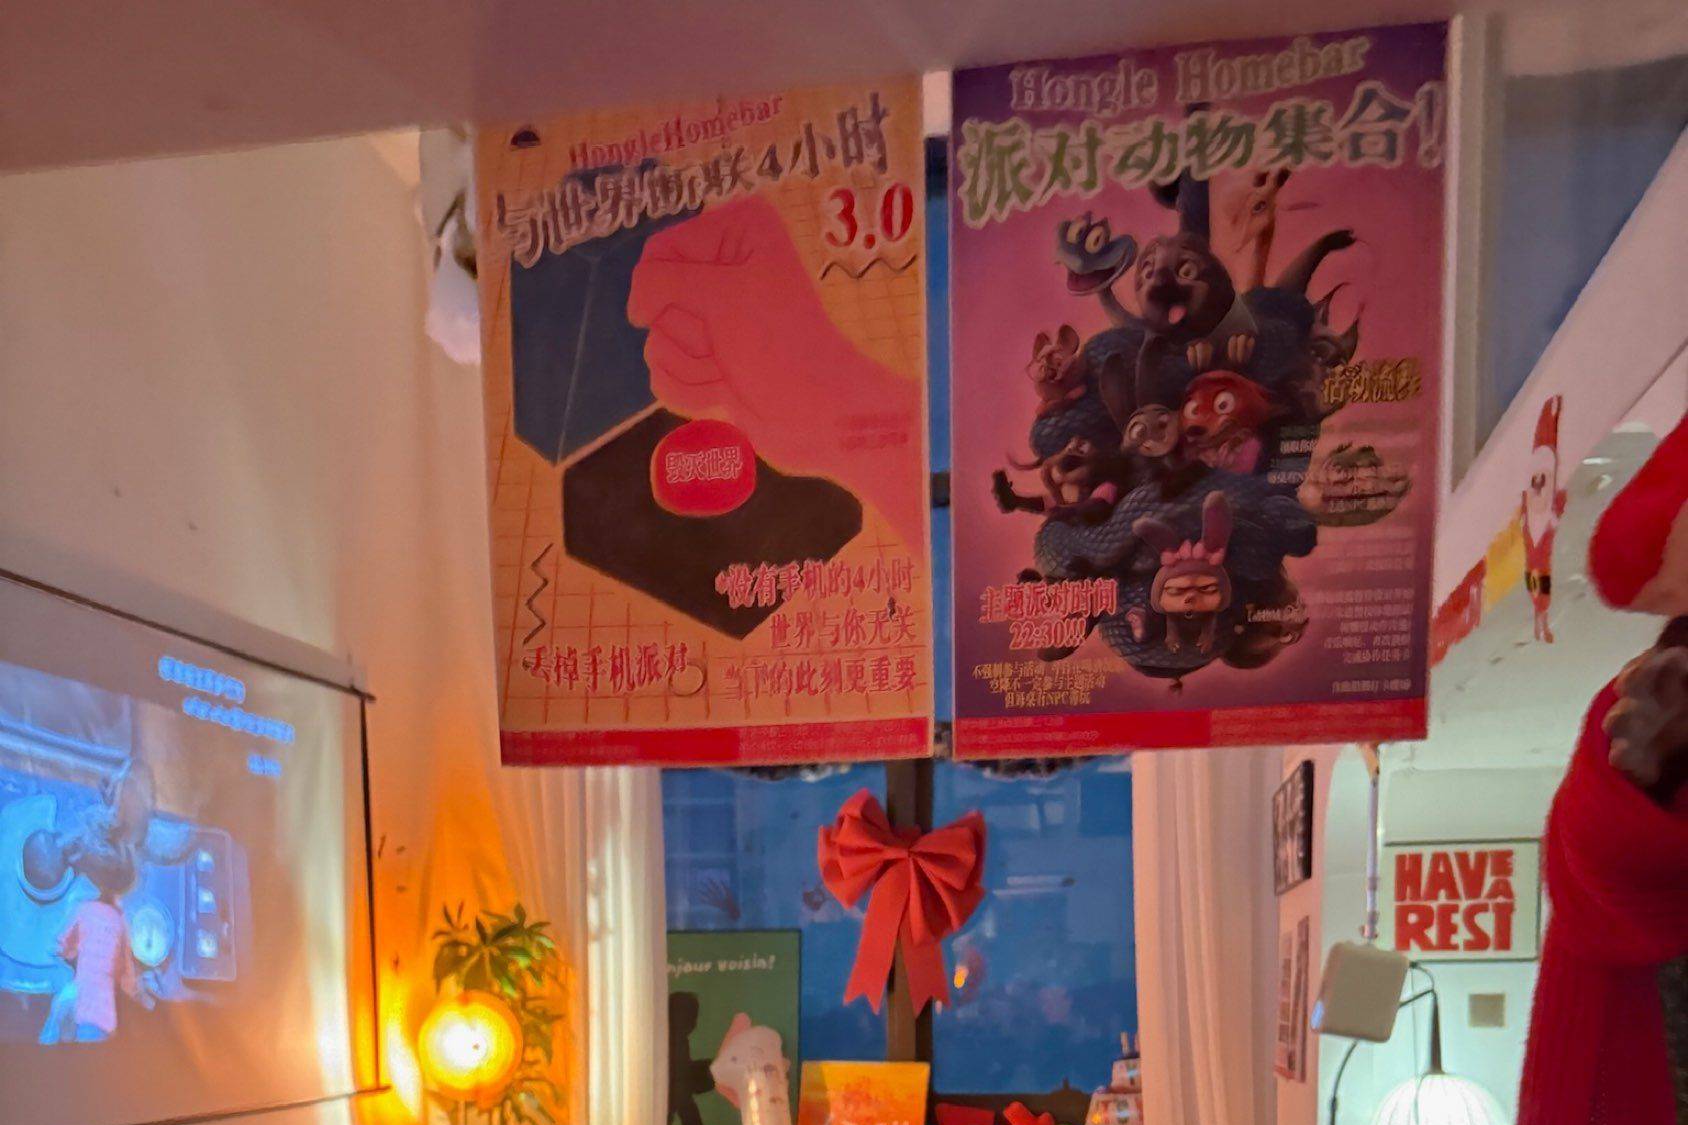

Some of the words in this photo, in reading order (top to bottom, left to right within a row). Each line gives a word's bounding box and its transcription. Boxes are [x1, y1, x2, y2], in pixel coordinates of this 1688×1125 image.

[824, 182, 915, 250] 3.0
[1395, 850, 1514, 901] HAVE
[1395, 902, 1514, 951] REST
